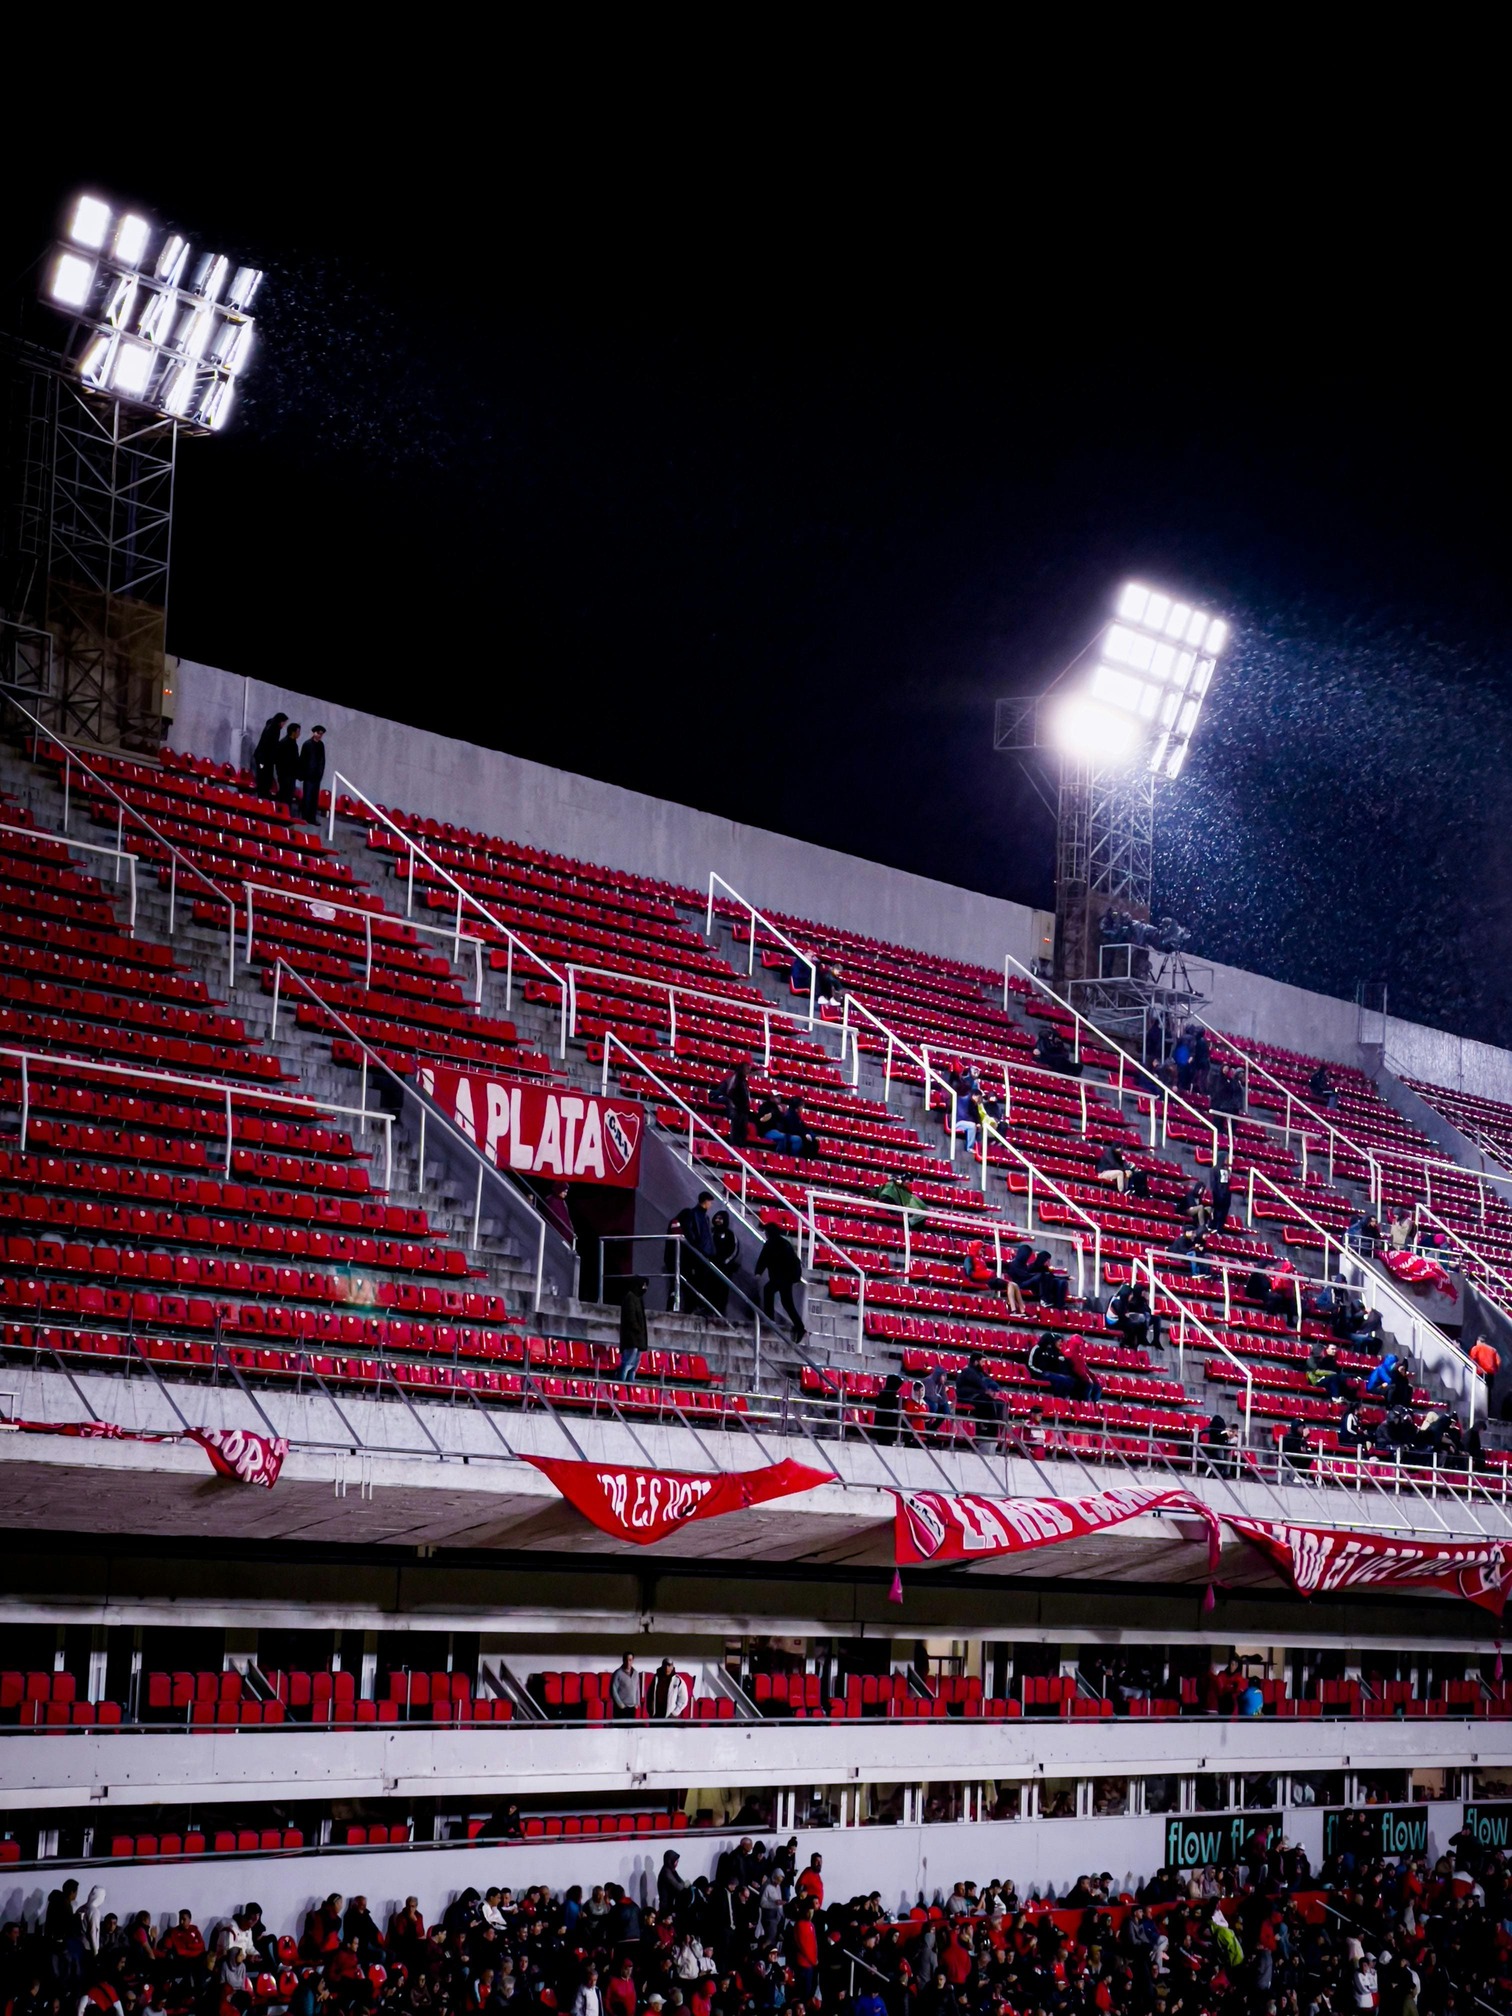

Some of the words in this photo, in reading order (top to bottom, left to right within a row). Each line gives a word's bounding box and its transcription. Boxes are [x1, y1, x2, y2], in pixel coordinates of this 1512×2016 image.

[485, 1082, 606, 1179] PLATA
[946, 1496, 1010, 1550] LA
[1168, 1821, 1222, 1866] flow
[1382, 1812, 1426, 1852] flow
